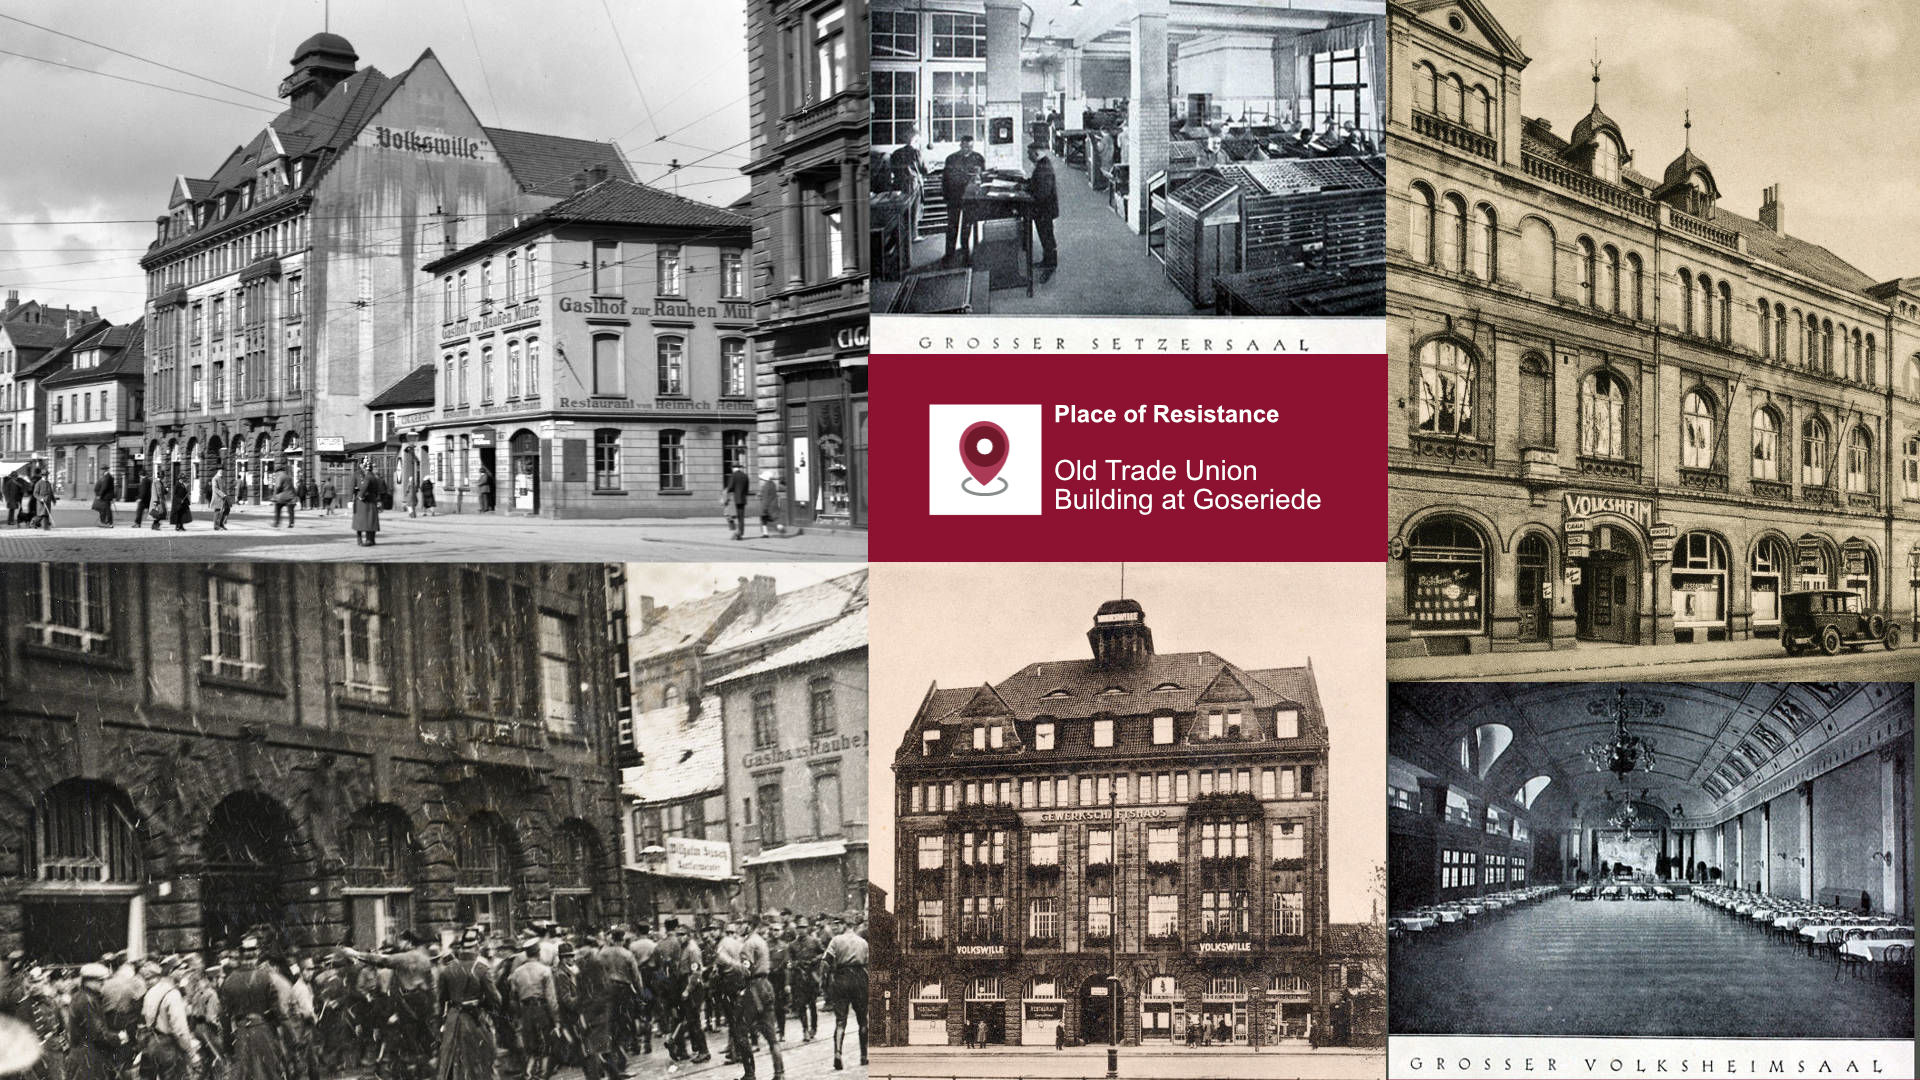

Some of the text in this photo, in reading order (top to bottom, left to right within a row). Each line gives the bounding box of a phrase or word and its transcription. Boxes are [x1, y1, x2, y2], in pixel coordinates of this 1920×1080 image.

[559, 297, 627, 314] Gasthof
[632, 306, 650, 316] zur
[654, 302, 717, 318] Rauhen
[560, 398, 634, 409] Restaurant
[656, 400, 710, 410] Heinrich
[1565, 494, 1652, 530] VOLKSHEIM
[956, 945, 1004, 954] VOLKSWILLE
[1200, 942, 1251, 951] VOLKSWILLE
